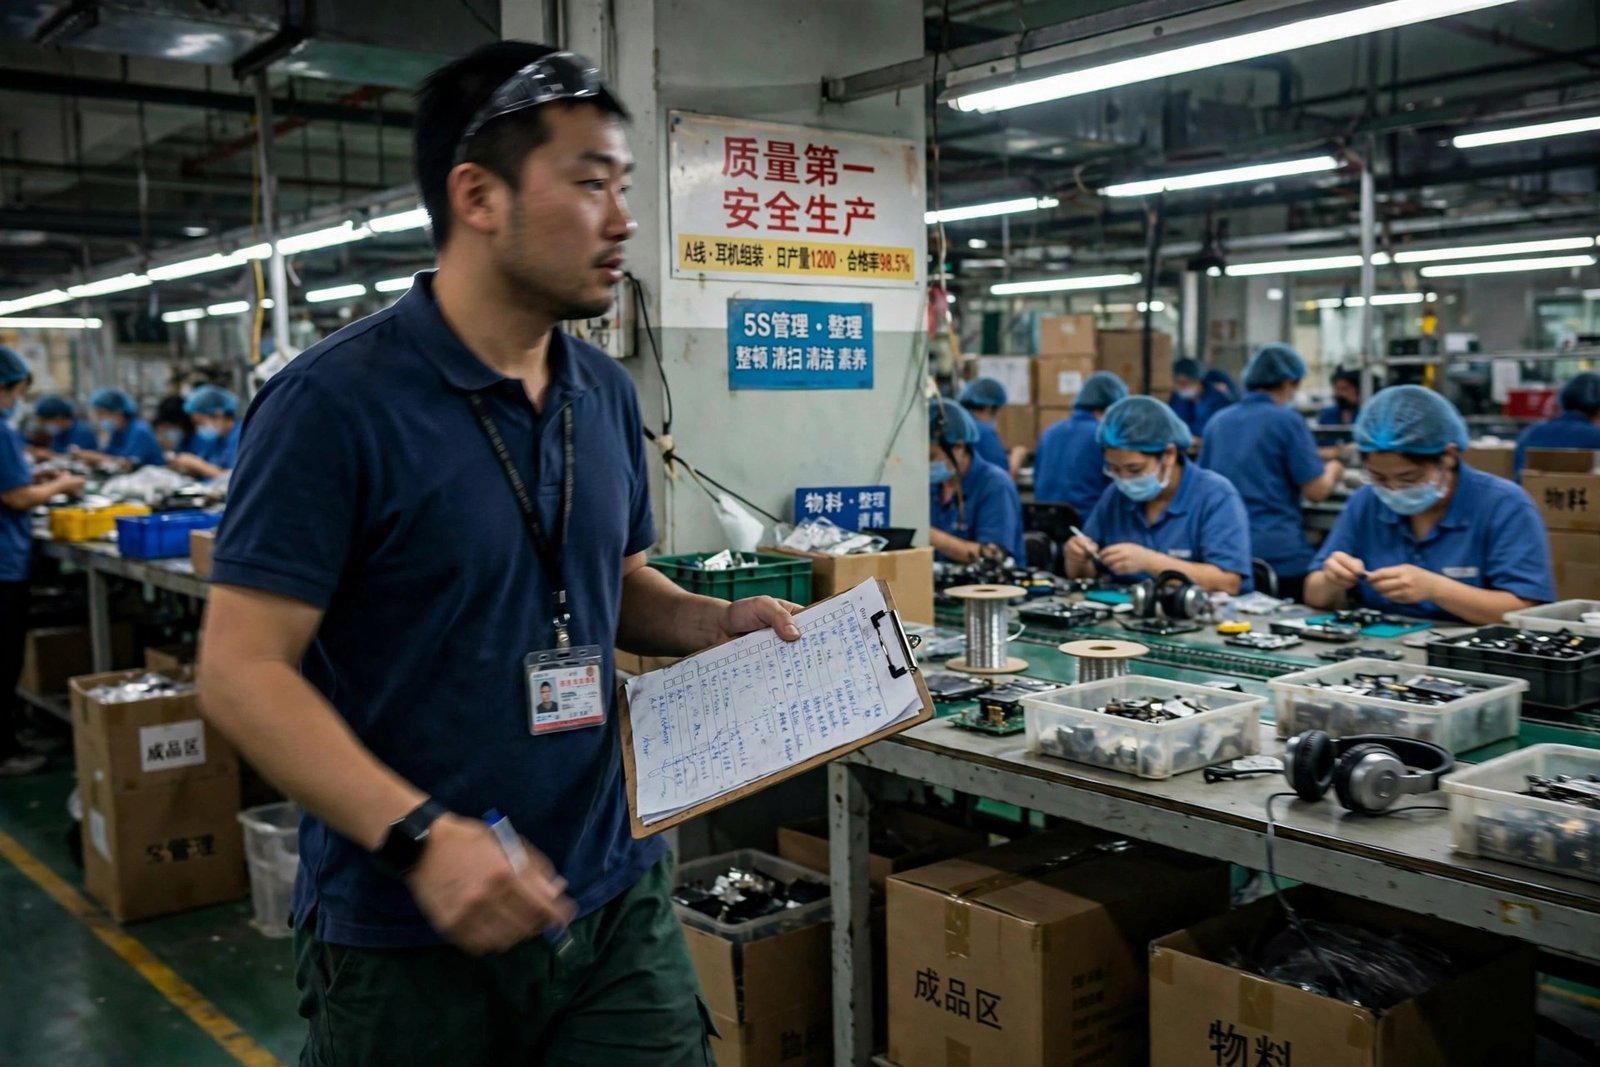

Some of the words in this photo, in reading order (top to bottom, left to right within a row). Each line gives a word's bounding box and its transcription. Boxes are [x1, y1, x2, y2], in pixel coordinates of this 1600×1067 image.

[721, 136, 875, 187] 质量第一
[723, 187, 876, 236] 安全生产
[147, 738, 200, 762] 成品区
[914, 967, 1003, 1030] 成品区
[1208, 1019, 1291, 1067] 物料
